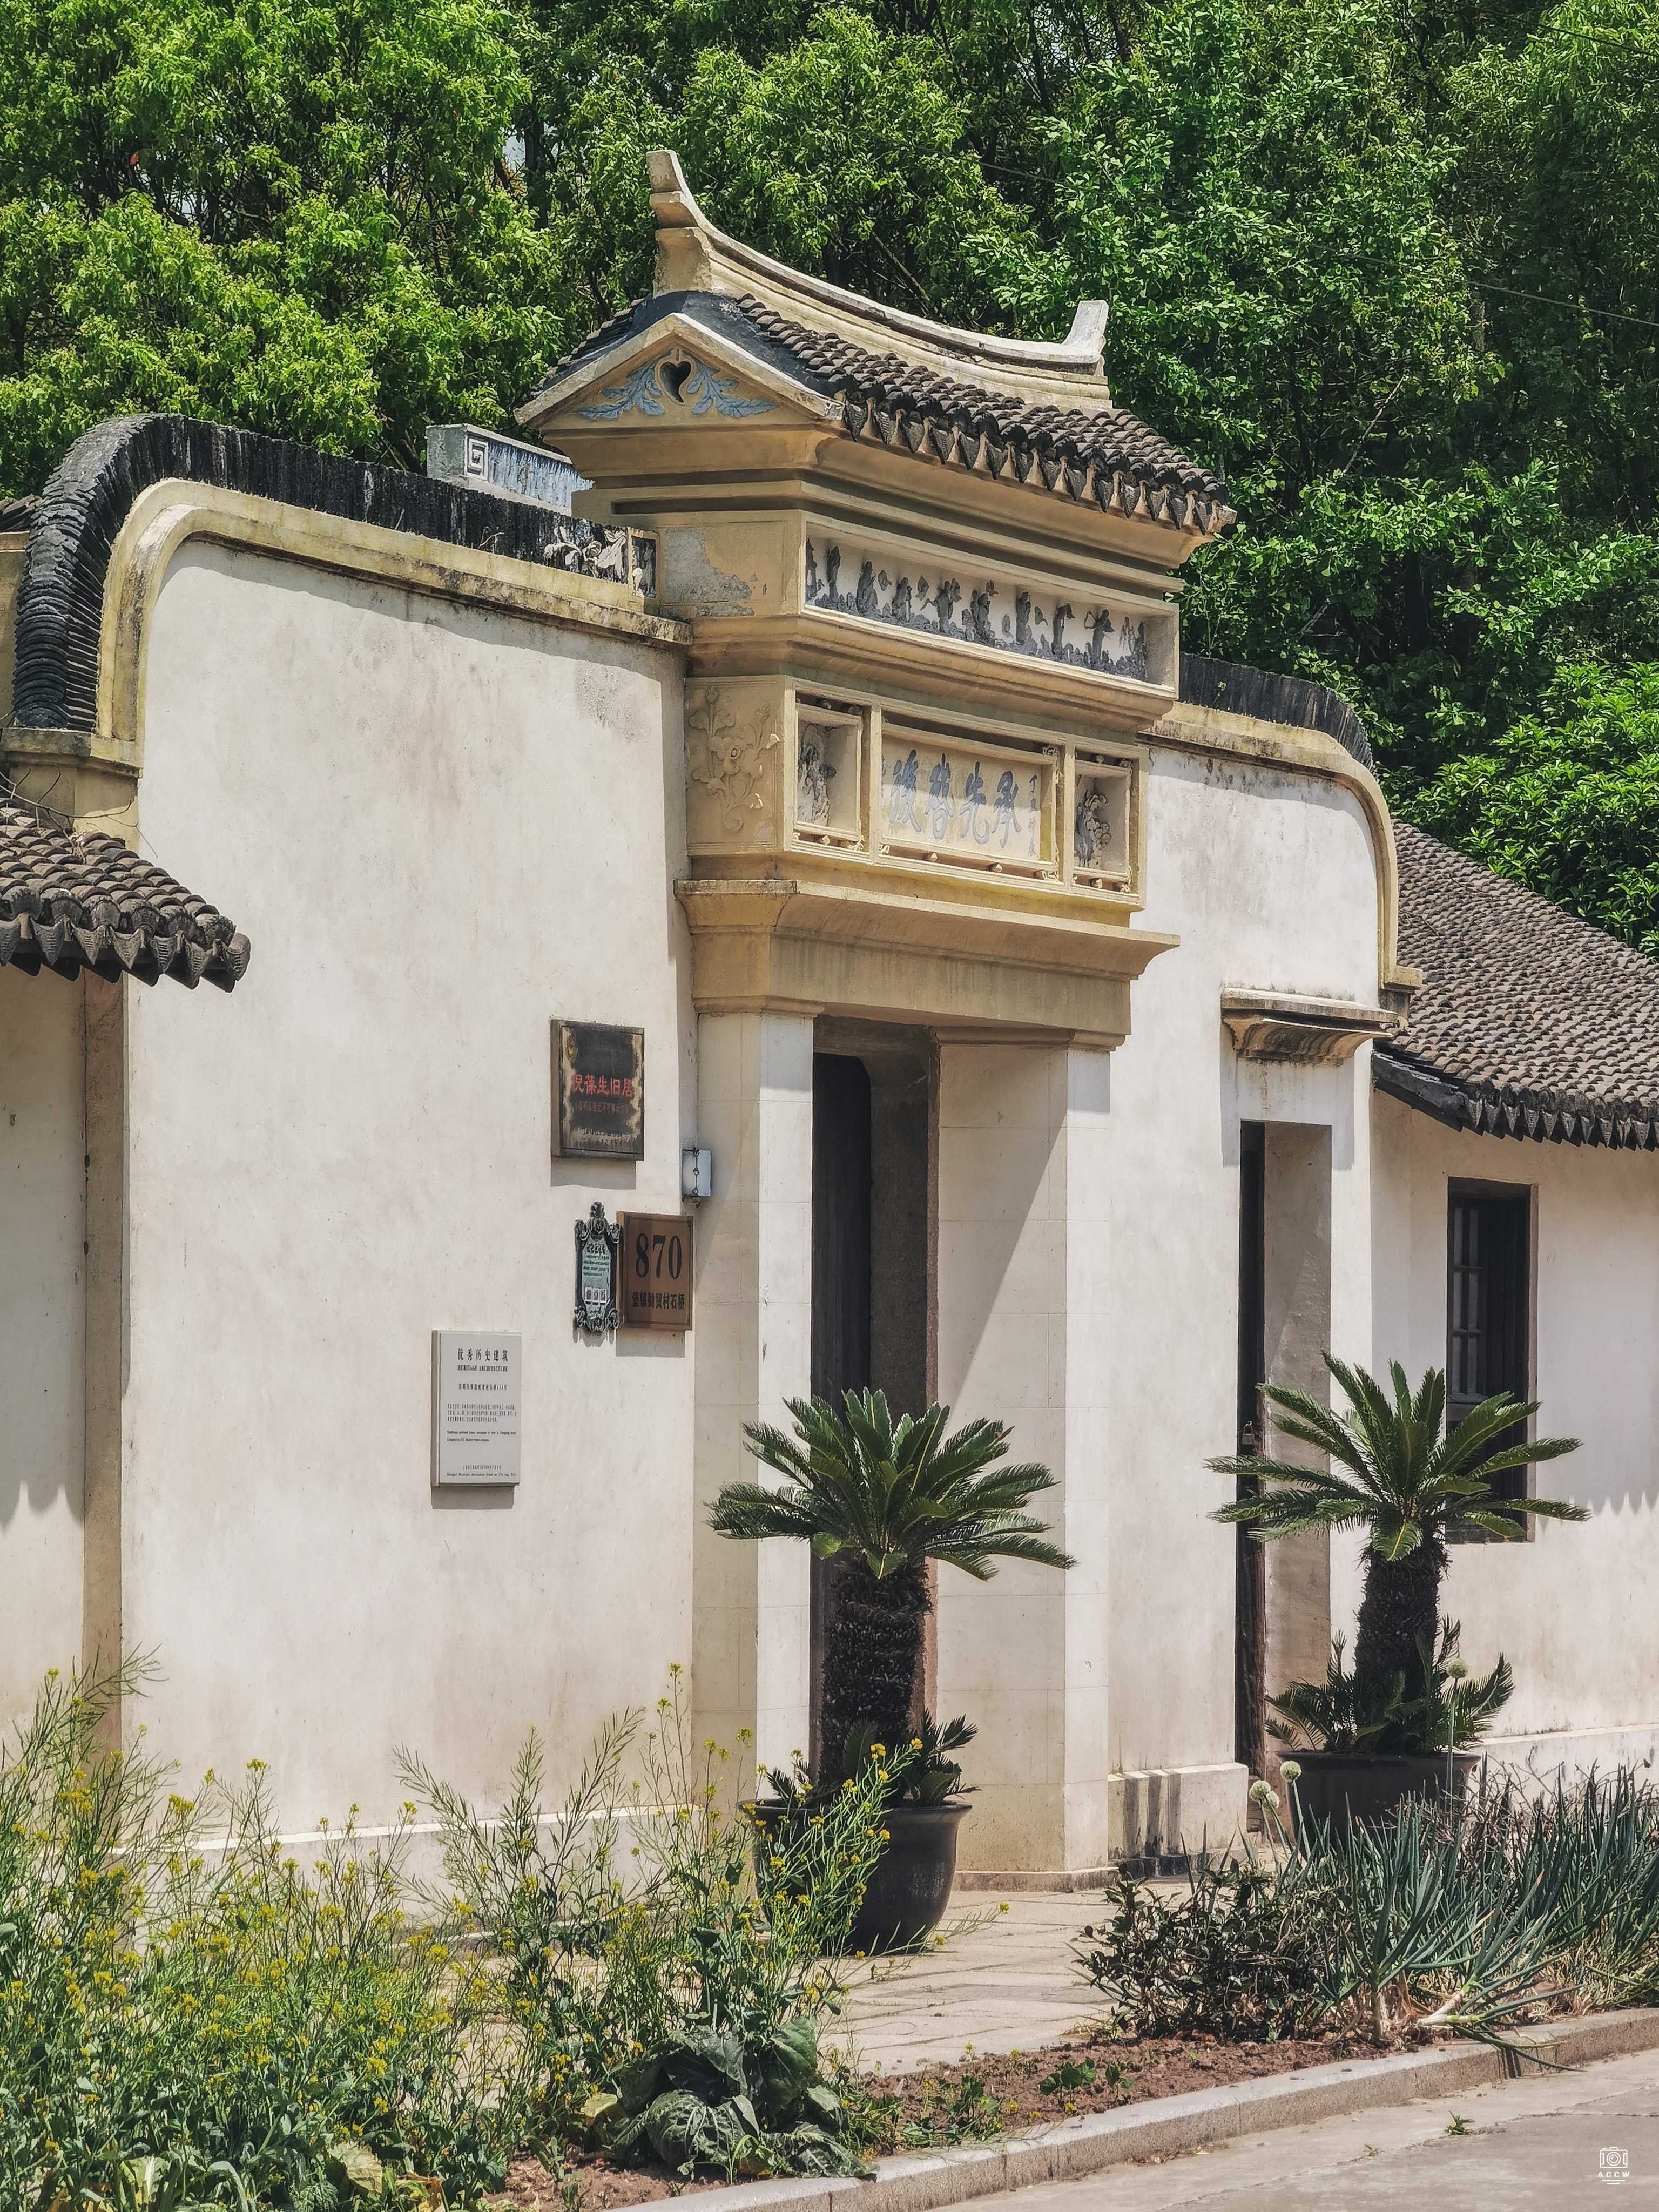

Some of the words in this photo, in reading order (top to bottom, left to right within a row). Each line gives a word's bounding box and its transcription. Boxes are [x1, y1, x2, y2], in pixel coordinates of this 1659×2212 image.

[636, 1233, 682, 1279] 870
[457, 1348, 508, 1361] 优秀历史建筑
